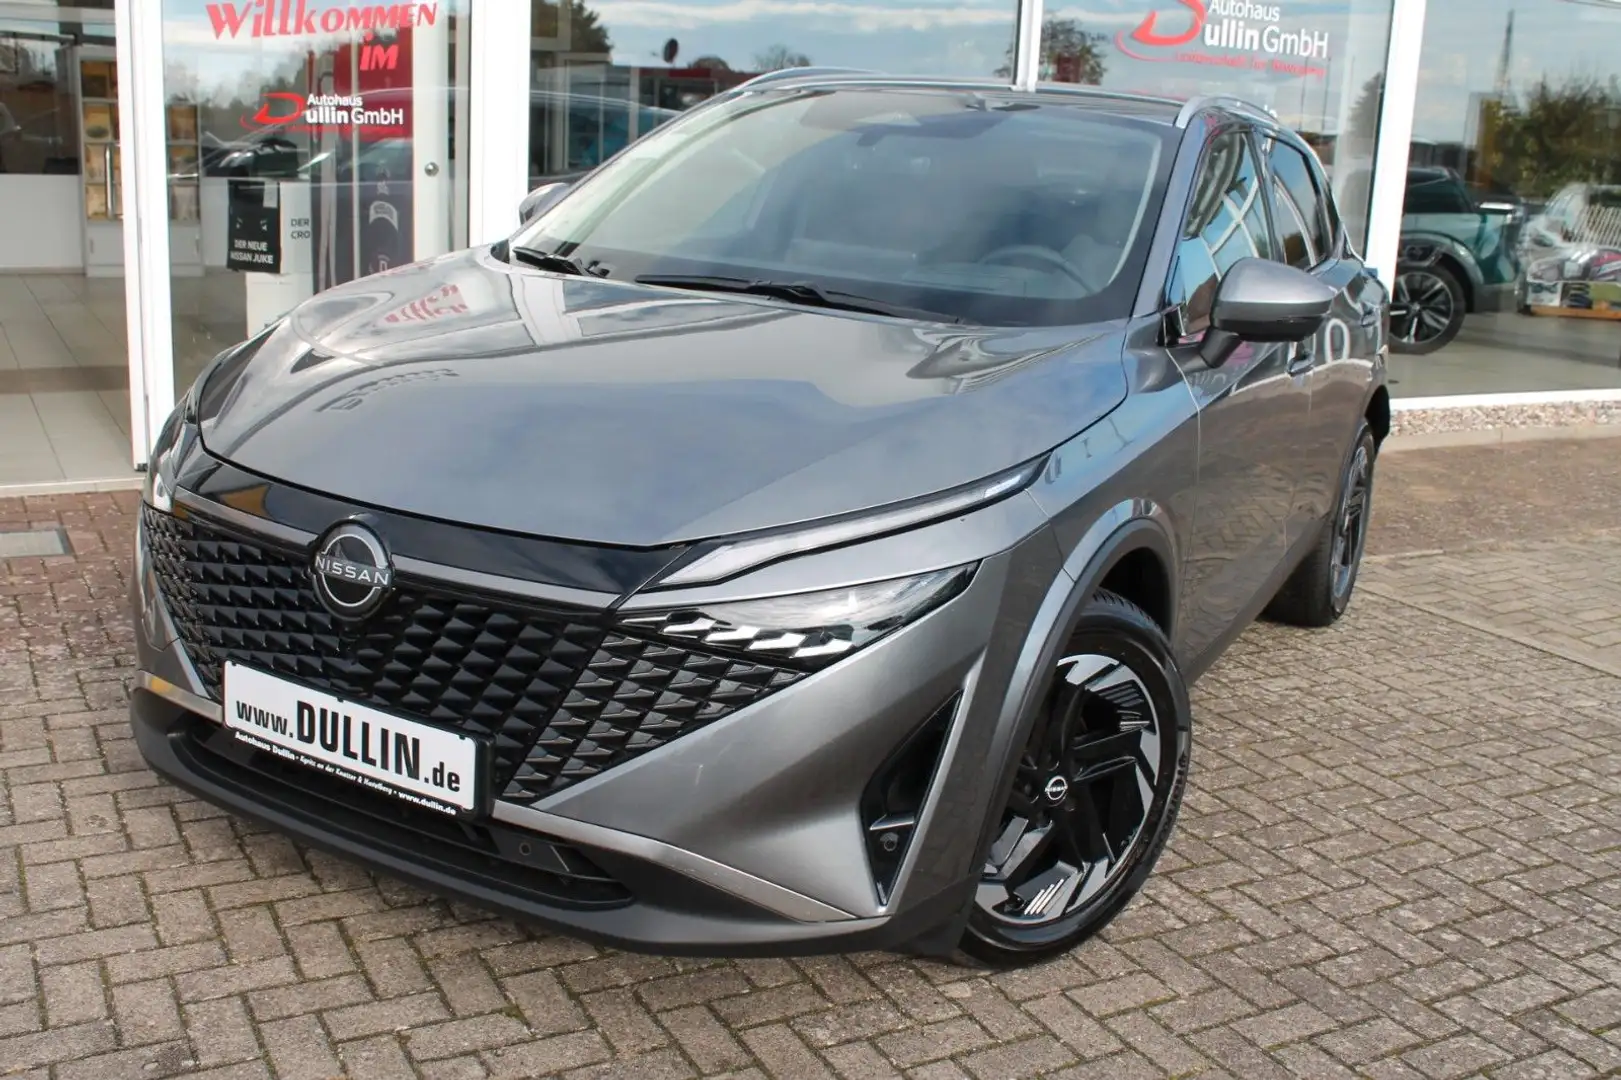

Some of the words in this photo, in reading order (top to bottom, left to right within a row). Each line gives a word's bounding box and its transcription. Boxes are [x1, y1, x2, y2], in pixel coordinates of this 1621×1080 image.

[1208, 0, 1280, 22] Autohaus
[1262, 26, 1329, 58] GmbH
[306, 93, 363, 107] Autohaus
[351, 108, 404, 125] GmbH
[290, 218, 310, 227] DER
[234, 239, 246, 248] DER
[247, 240, 268, 251] NEUE
[230, 251, 252, 262] NISSAN
[253, 253, 274, 264] JUKE
[315, 555, 389, 585] NISSAN
[236, 700, 460, 792] www.DULLIN.de
[234, 731, 271, 751] Autohaus
[272, 744, 295, 760] Dullin
[398, 792, 457, 816] www.dullin.de
